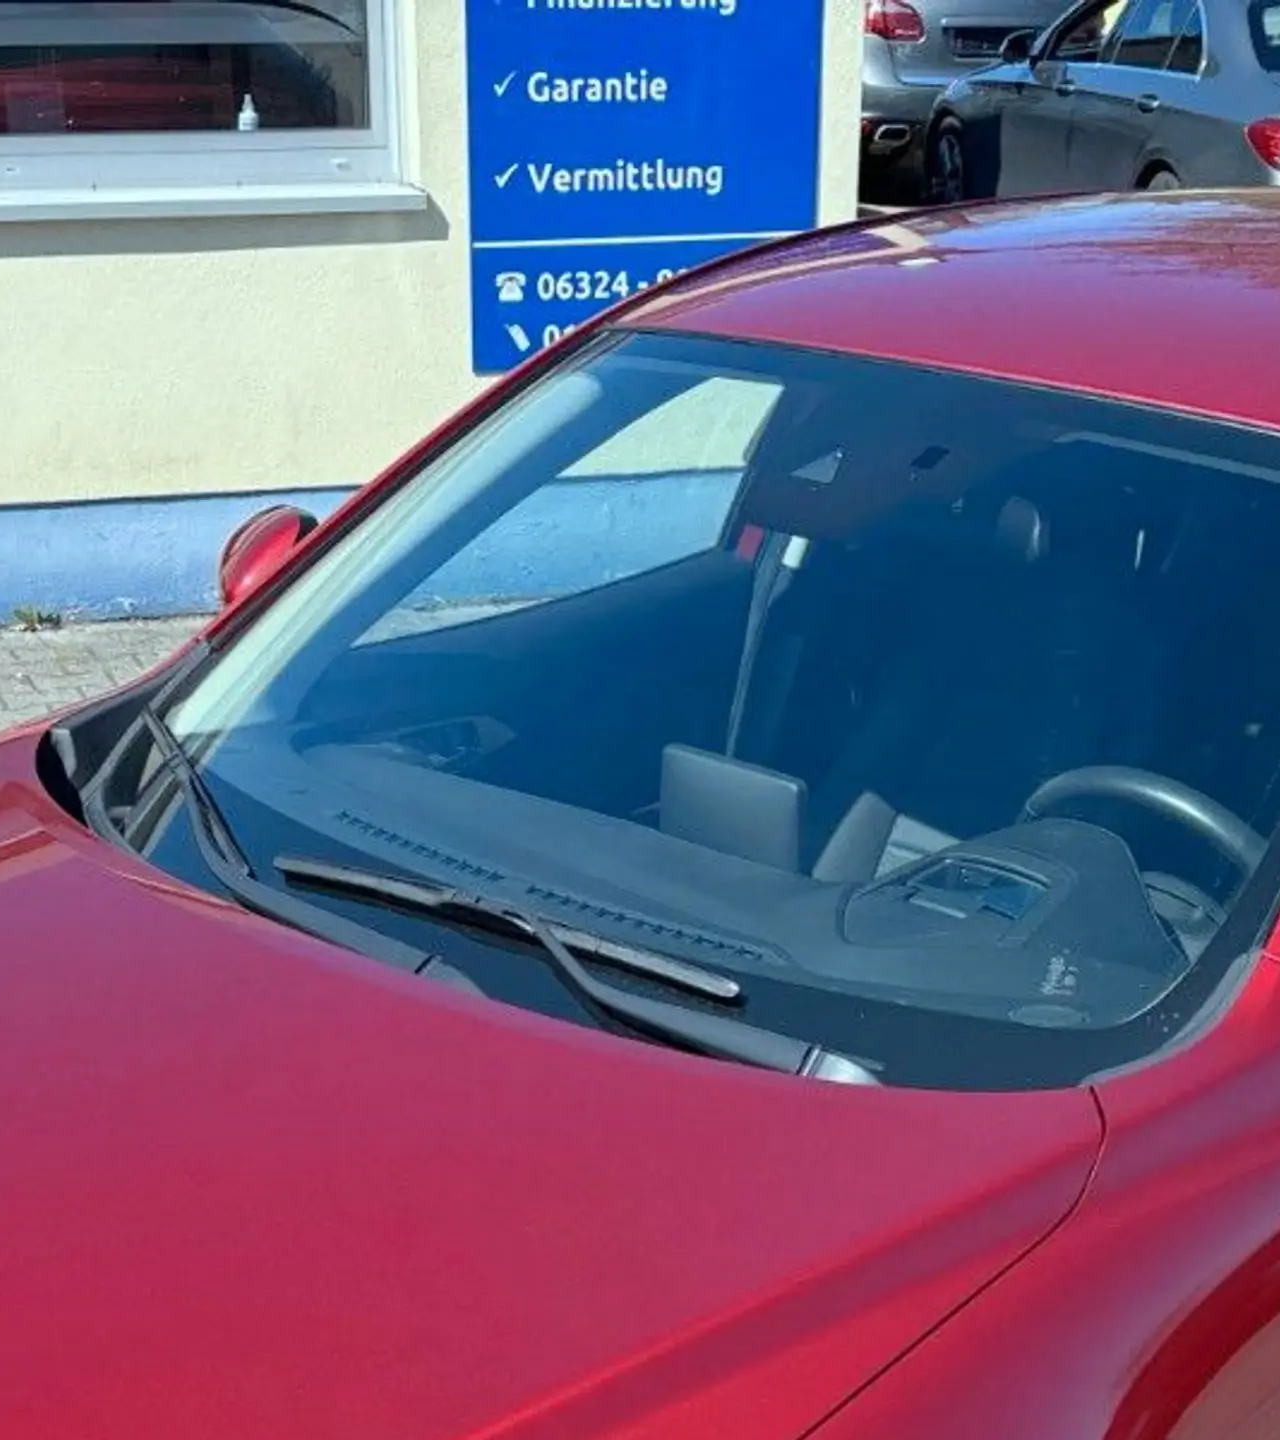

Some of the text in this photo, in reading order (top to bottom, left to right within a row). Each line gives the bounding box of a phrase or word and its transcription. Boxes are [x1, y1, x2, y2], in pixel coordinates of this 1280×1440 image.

[527, 68, 668, 102] Garantie
[527, 158, 723, 196] Vermittlung
[537, 270, 629, 300] 06324
